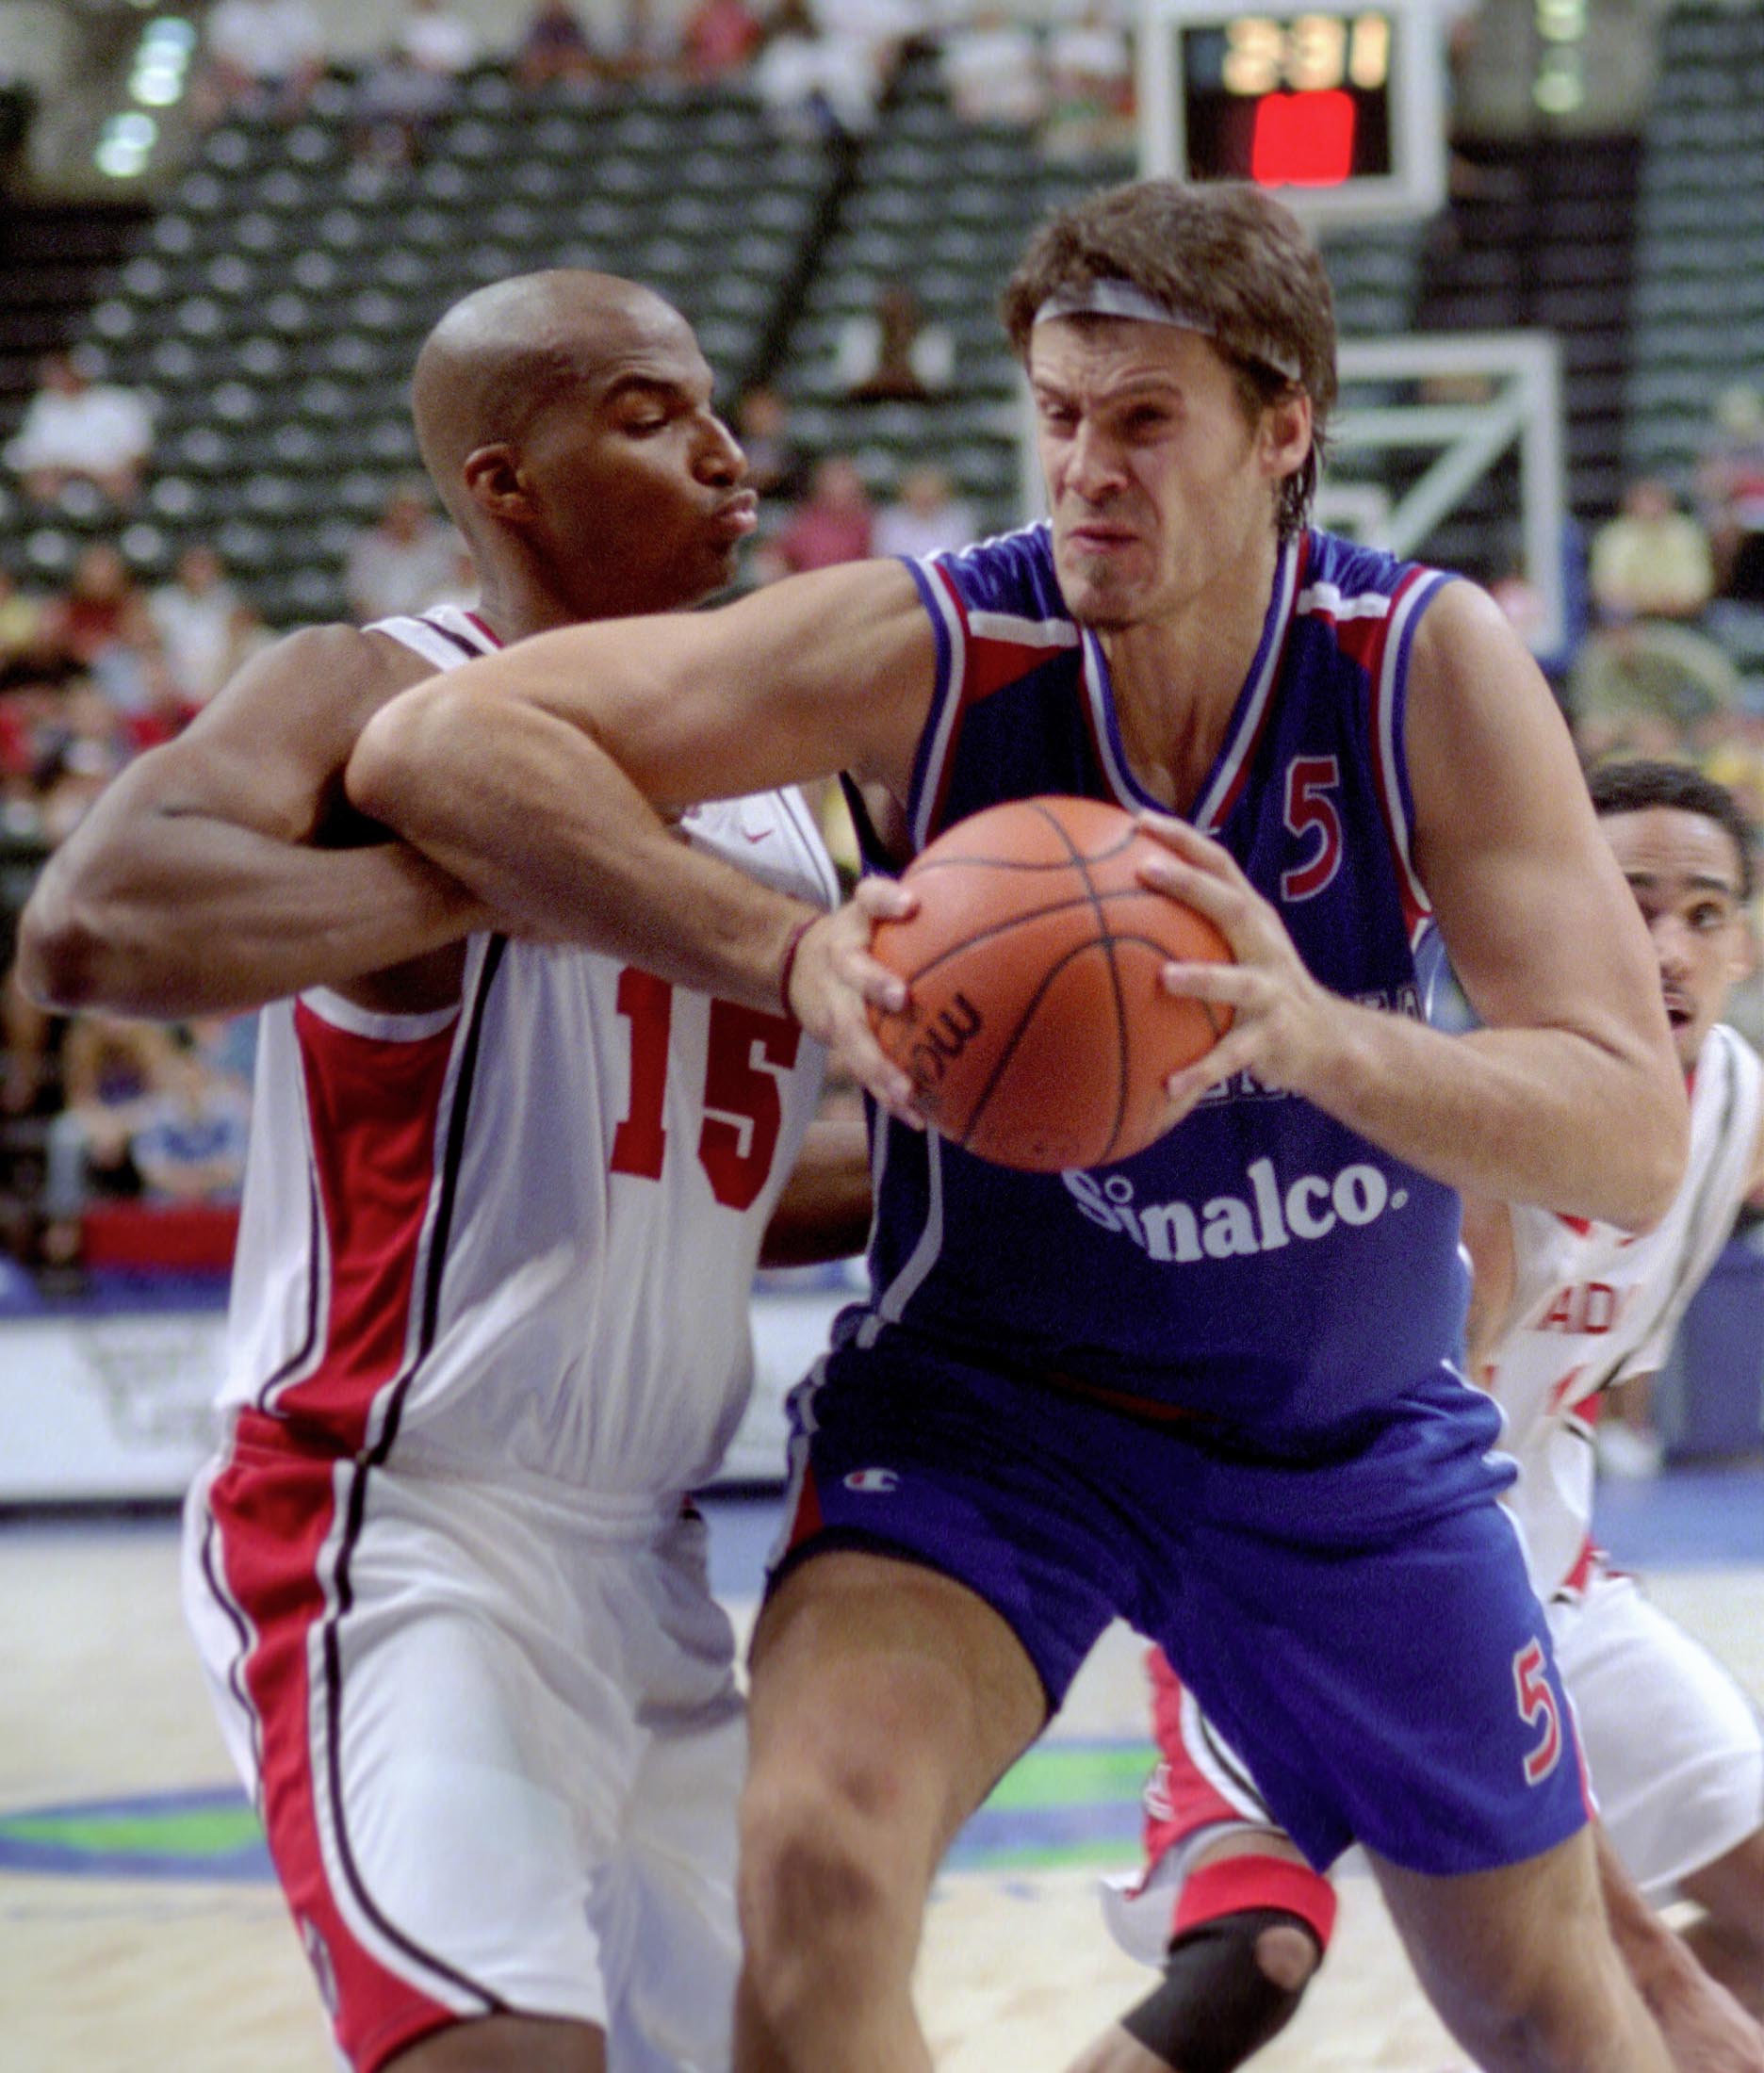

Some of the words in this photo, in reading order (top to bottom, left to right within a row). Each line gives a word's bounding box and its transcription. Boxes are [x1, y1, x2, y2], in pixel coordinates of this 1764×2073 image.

[1281, 756, 1343, 902] 5
[611, 966, 803, 1213] 15
[1511, 1635, 1562, 1786] 5
